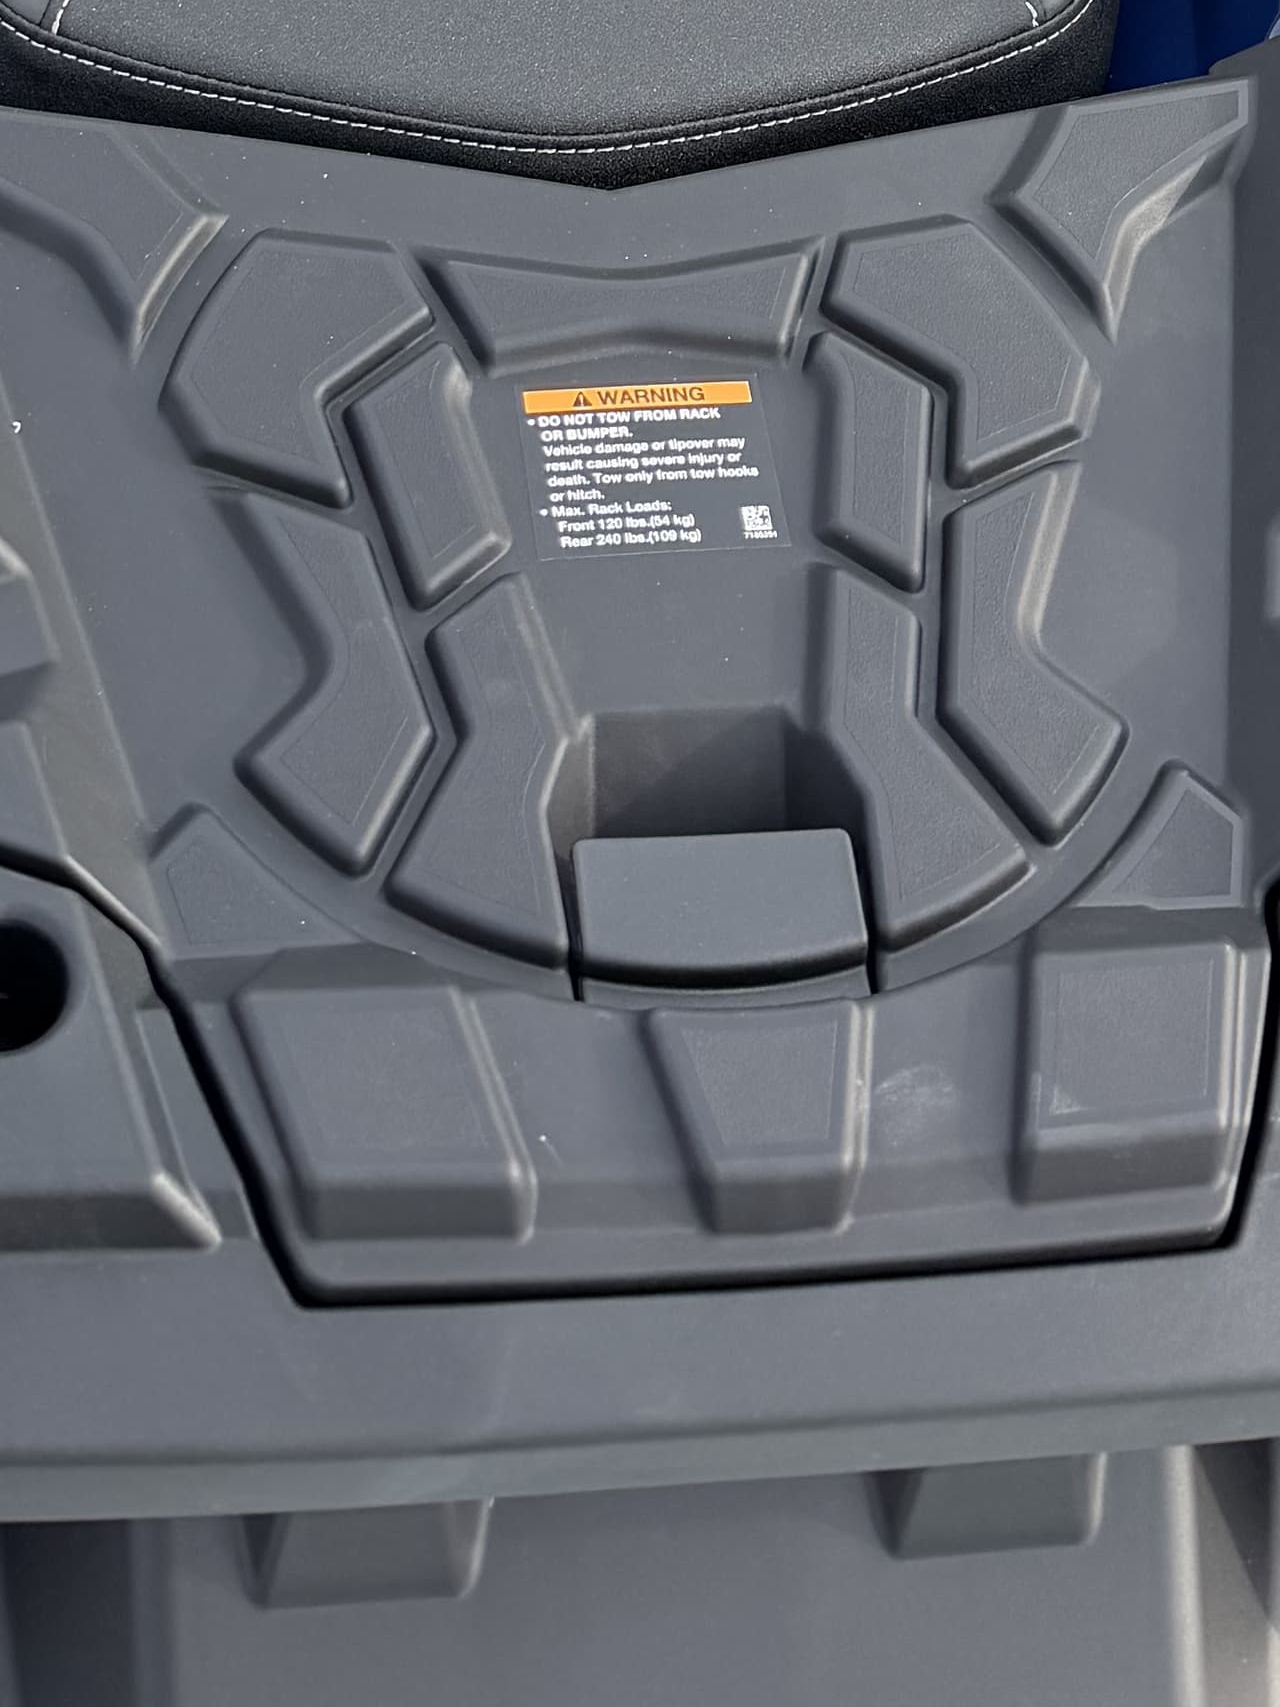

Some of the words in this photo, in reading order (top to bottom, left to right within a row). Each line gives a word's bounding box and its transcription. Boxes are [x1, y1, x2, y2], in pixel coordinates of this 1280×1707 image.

[597, 386, 705, 405] WARNING
[536, 414, 561, 427] DO
[563, 413, 594, 426] NOT
[596, 411, 632, 424] TOW
[633, 408, 677, 422] FROM
[678, 406, 721, 420] RACK
[540, 429, 564, 442] OR
[566, 426, 634, 441] BUMPER.
[542, 443, 592, 456] Vehicle
[594, 441, 649, 456] damage
[650, 441, 667, 450] or
[667, 437, 715, 451] tipover
[716, 436, 746, 450] may
[544, 459, 584, 473] result
[585, 456, 640, 471] causing
[641, 454, 686, 468] severe
[687, 452, 725, 465] injury
[726, 451, 743, 463] or
[547, 473, 590, 488] death.
[593, 471, 623, 485] Tow
[623, 470, 654, 483] only
[654, 468, 688, 482] from
[689, 466, 716, 480] tow
[716, 464, 759, 478] hooks
[549, 490, 565, 502] or
[566, 488, 605, 501] hitch.
[550, 504, 585, 518] Max.
[587, 502, 623, 515] Rack
[625, 499, 672, 513] Loads:
[557, 518, 595, 534] Front
[598, 517, 623, 531] 120
[672, 512, 696, 527] kg)
[559, 534, 594, 549] Rear
[594, 533, 621, 547] 240
[678, 528, 702, 542] kg)
